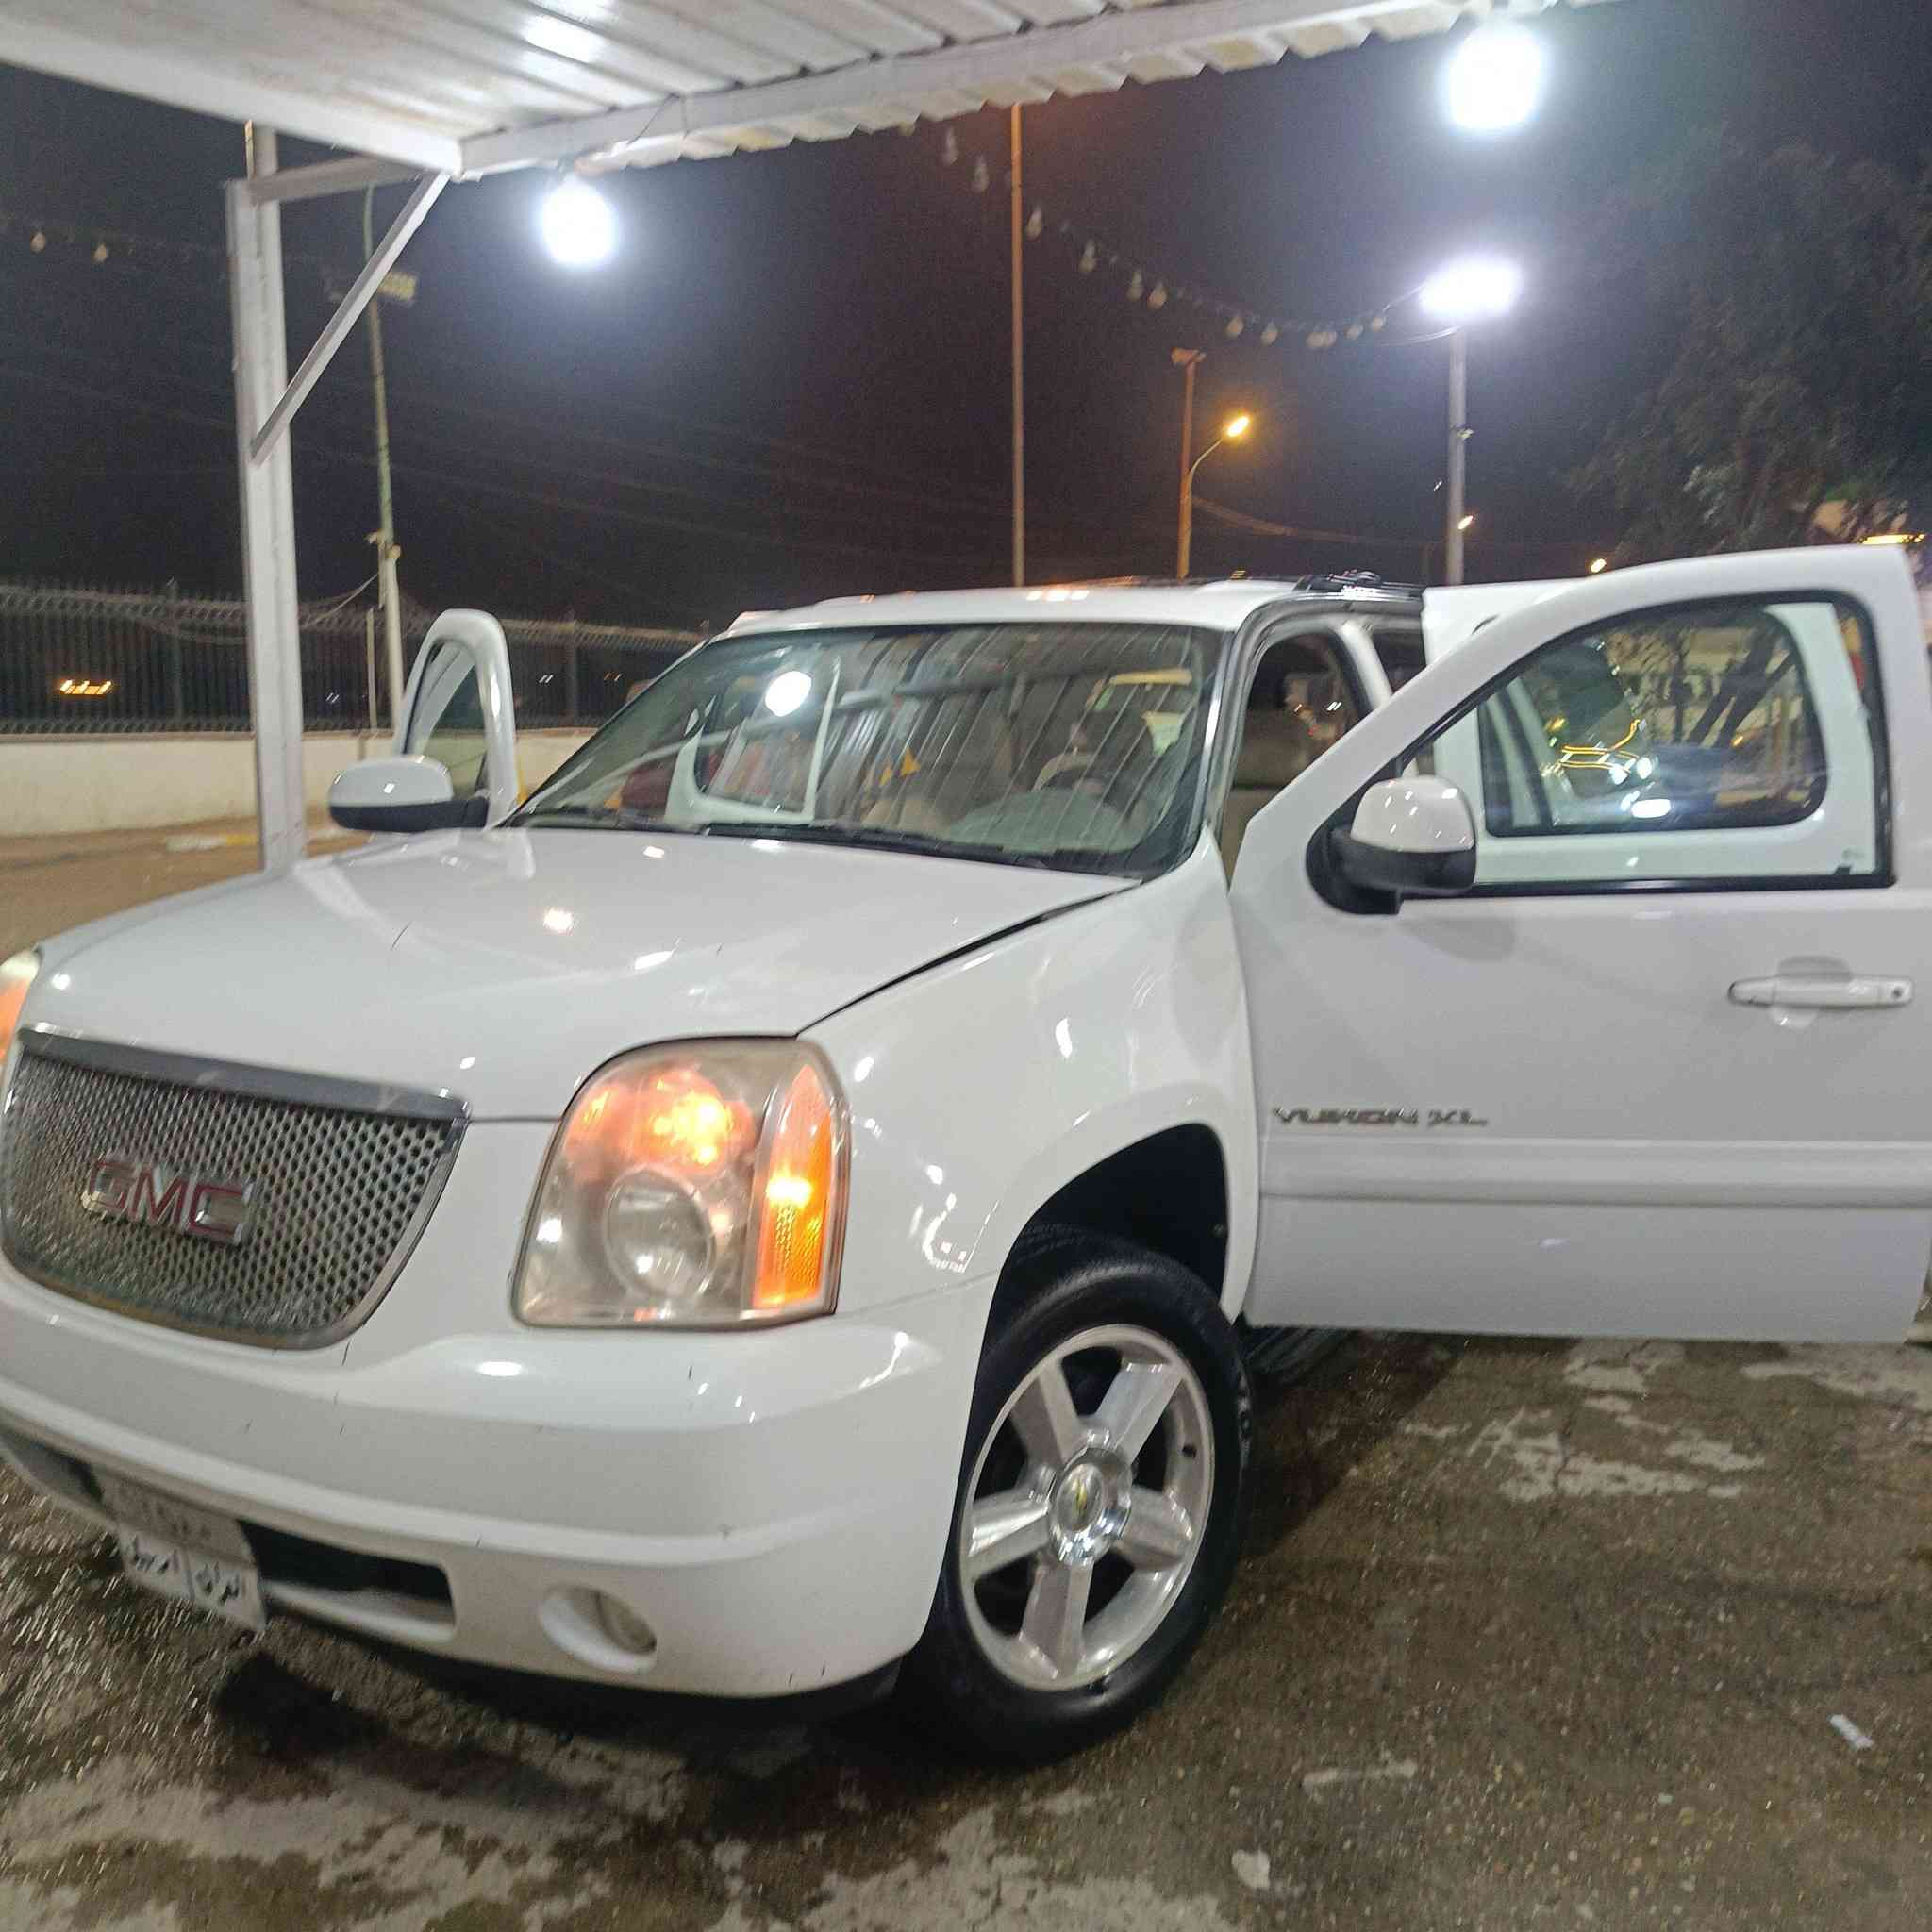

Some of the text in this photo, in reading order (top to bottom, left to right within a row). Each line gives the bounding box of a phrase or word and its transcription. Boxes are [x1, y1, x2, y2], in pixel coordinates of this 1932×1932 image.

[1273, 1107, 1490, 1126] YUKON XL
[81, 1152, 254, 1245] GMC
